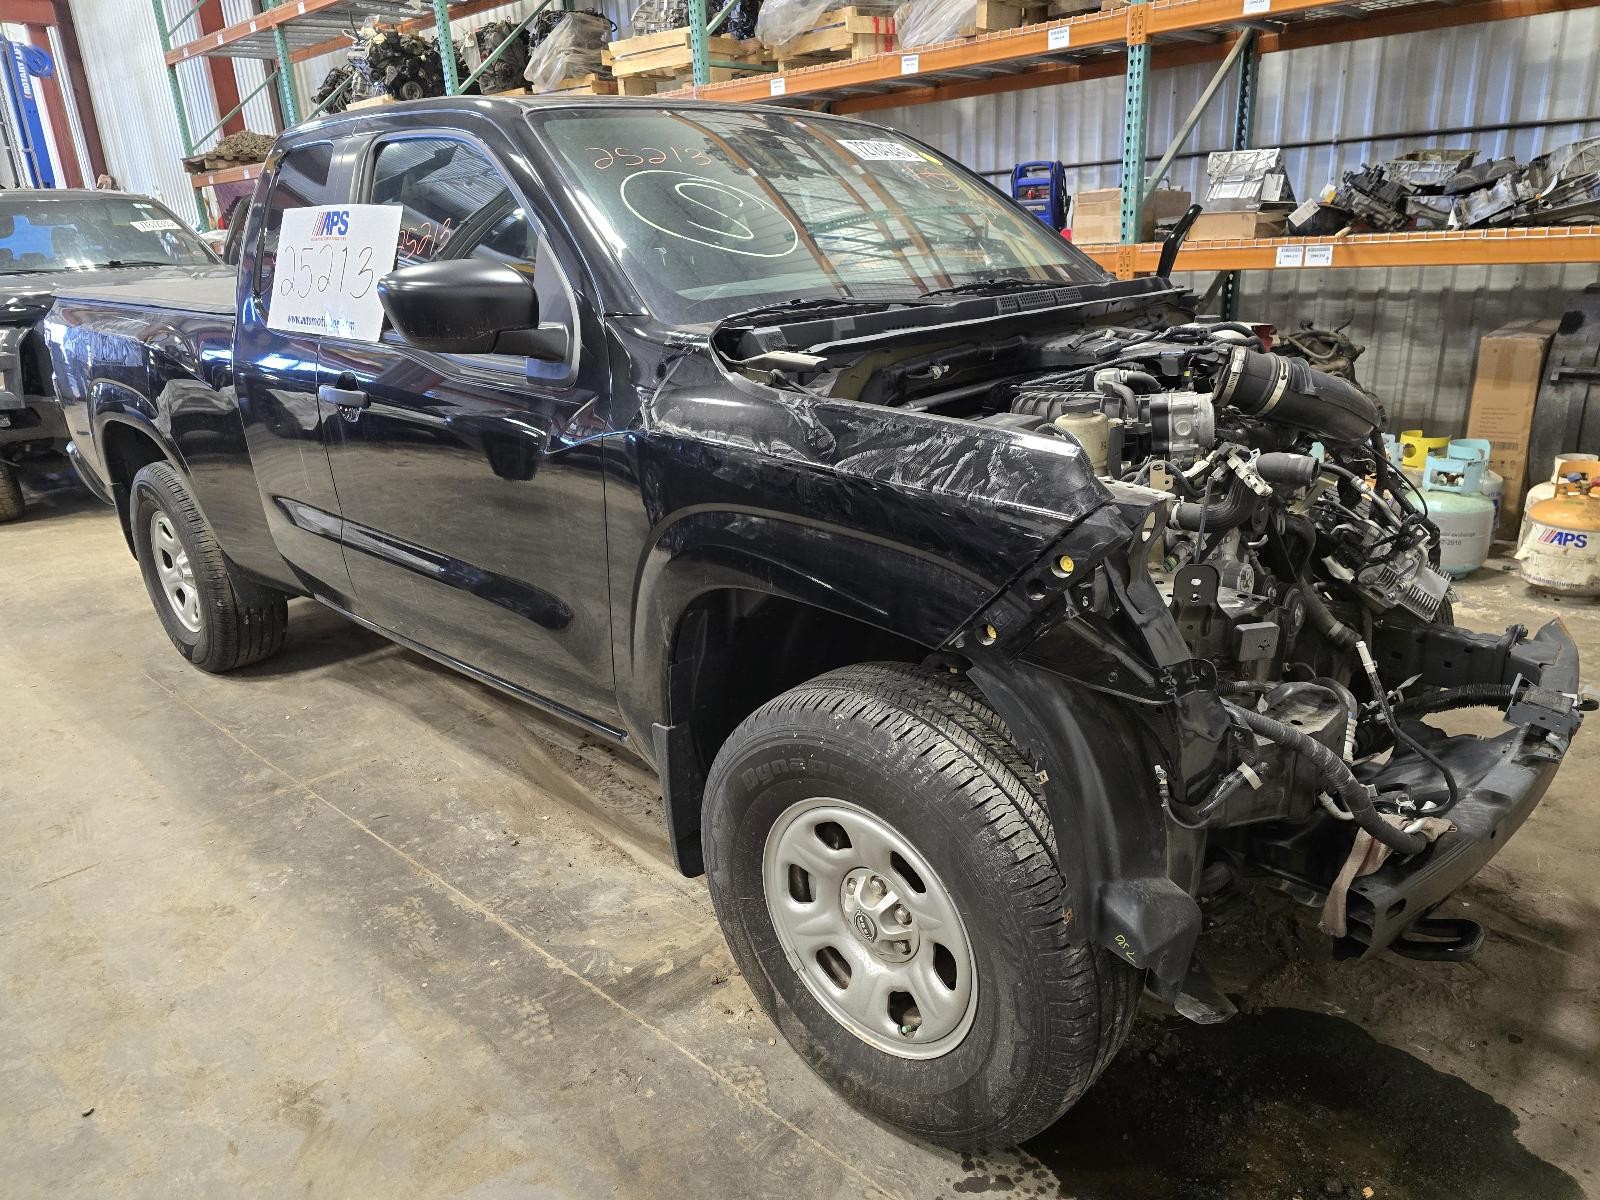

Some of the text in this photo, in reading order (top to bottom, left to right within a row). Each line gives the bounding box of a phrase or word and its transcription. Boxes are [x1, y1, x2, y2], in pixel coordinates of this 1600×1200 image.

[585, 146, 712, 170] 25213
[319, 210, 350, 236] APS
[280, 244, 374, 299] 25213
[1549, 531, 1588, 549] APS
